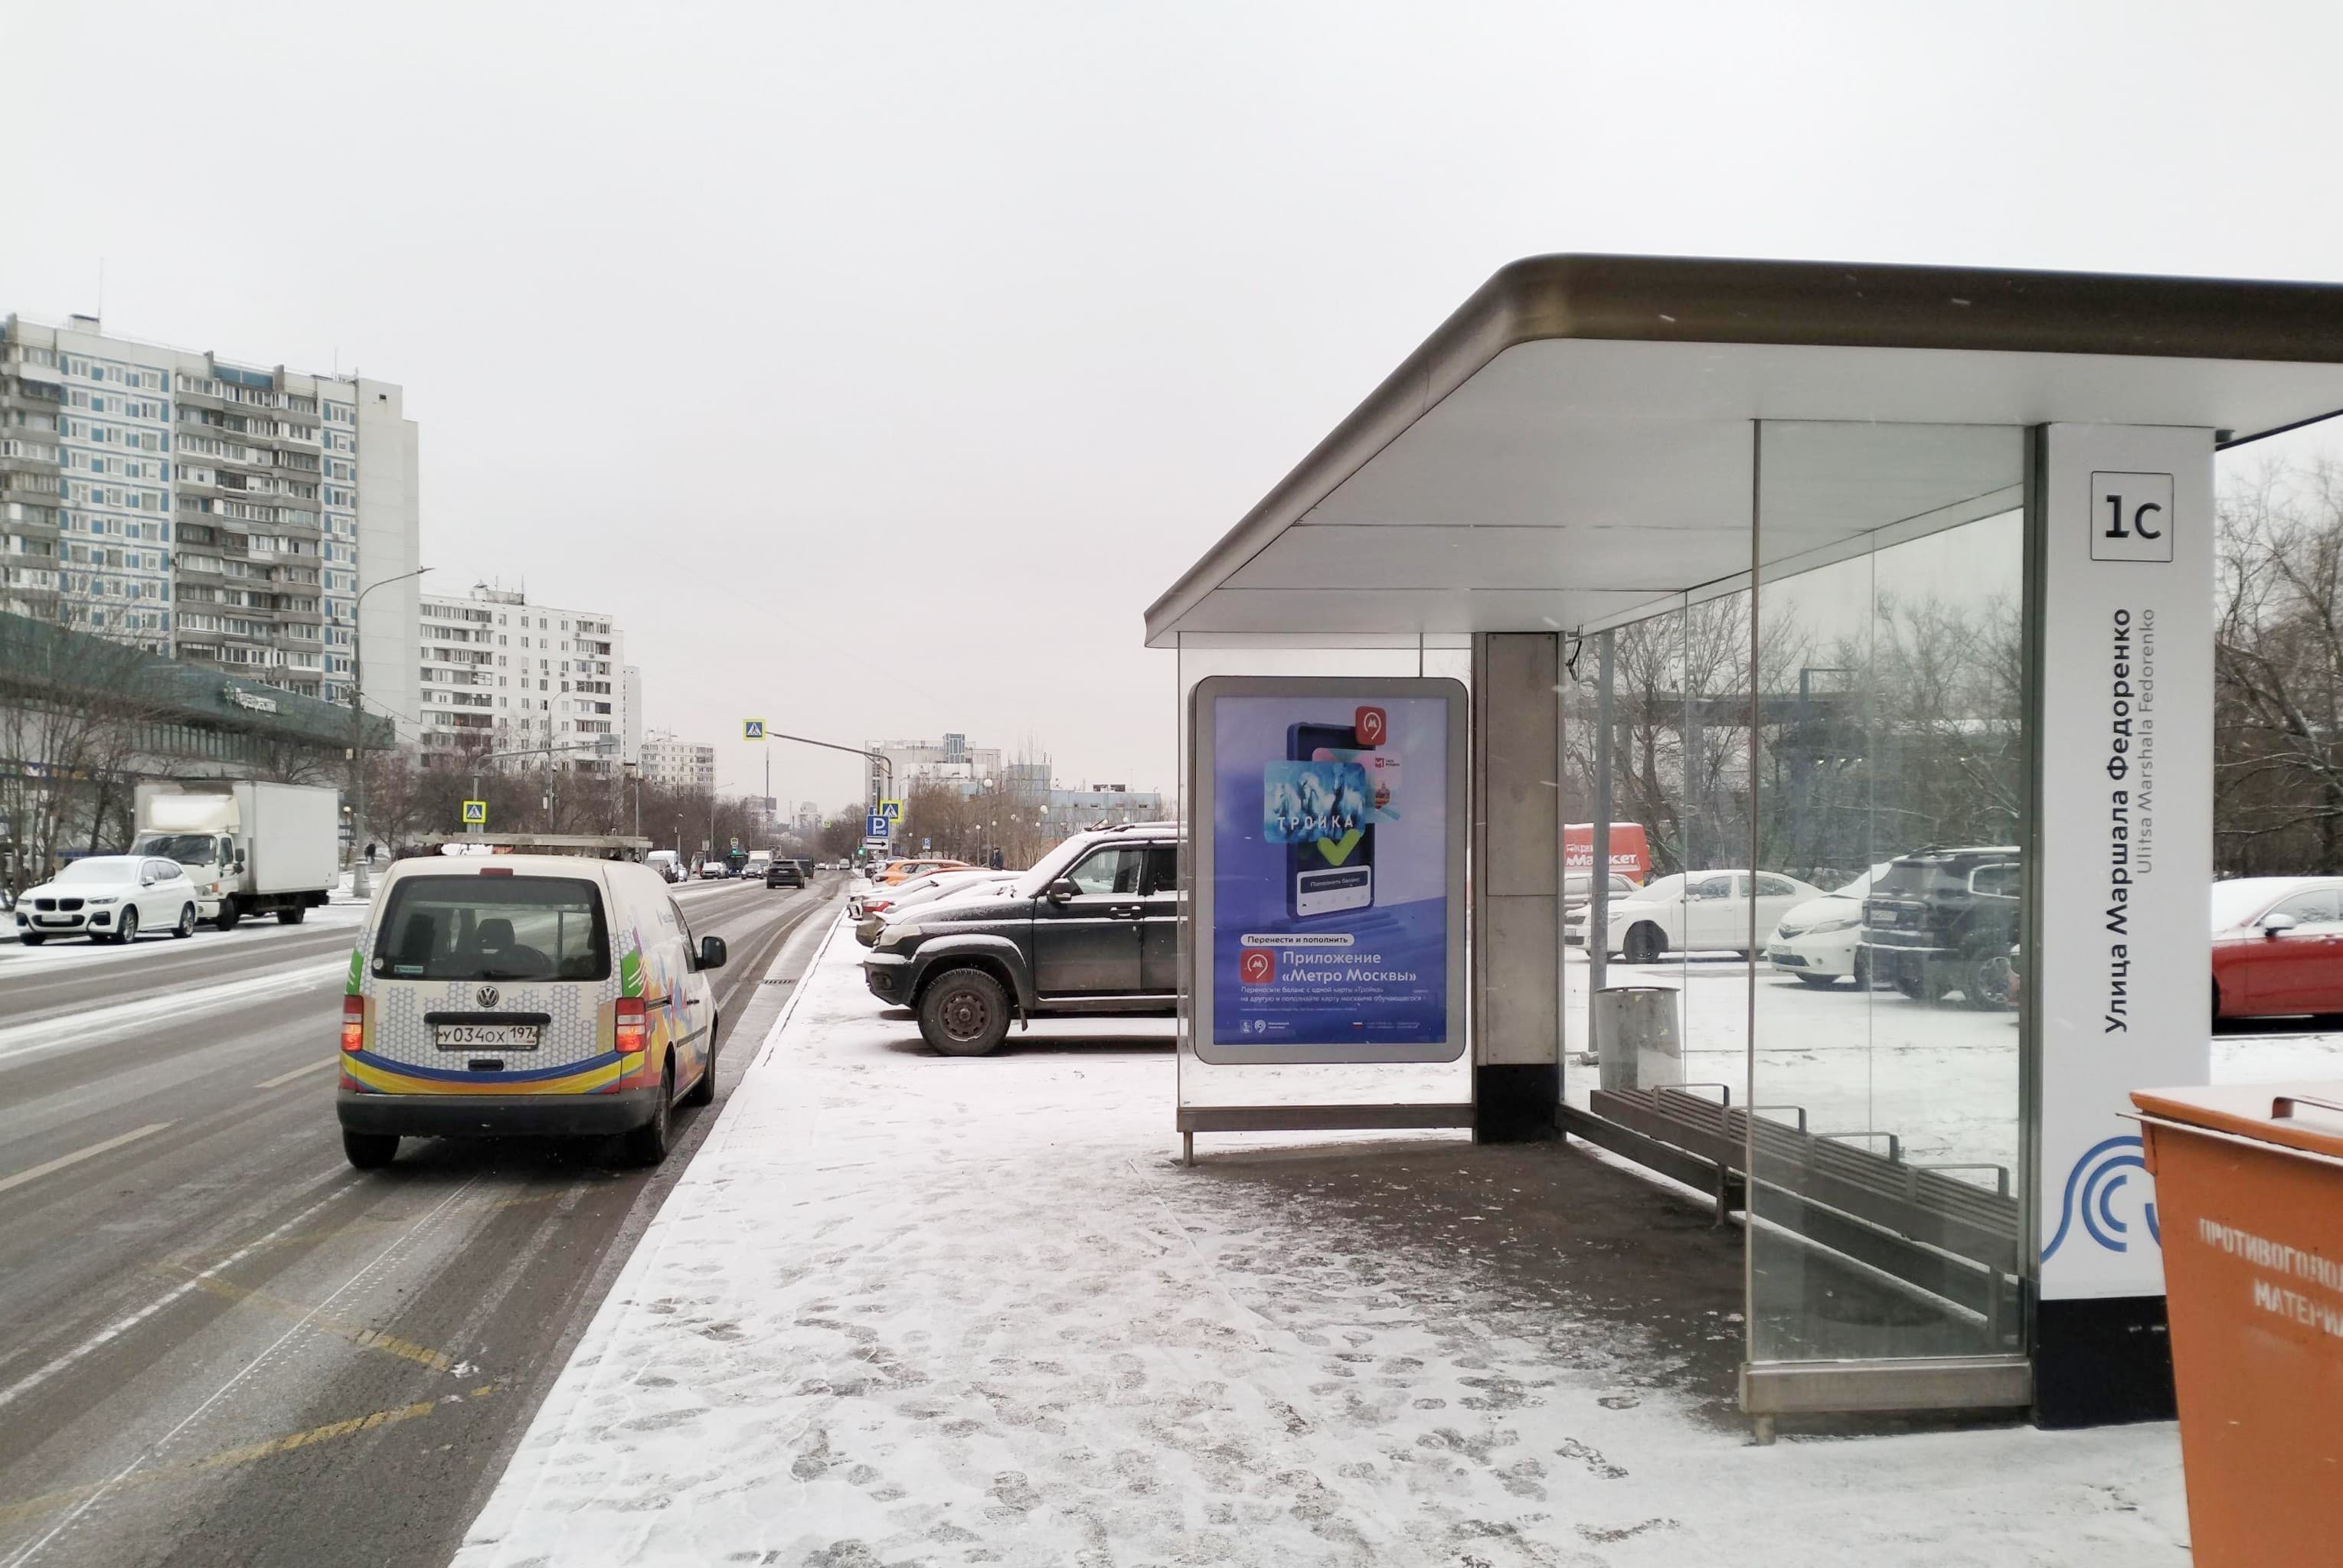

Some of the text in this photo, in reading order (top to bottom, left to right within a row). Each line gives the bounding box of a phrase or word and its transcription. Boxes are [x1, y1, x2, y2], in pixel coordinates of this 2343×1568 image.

[2136, 609, 2155, 874] Ulitsa Marshala Fedorenko
[873, 817, 886, 835] P
[1277, 815, 1354, 831] ТРОЙКА
[2106, 609, 2135, 1034] Улица Маршала Федоренко
[1567, 854, 1637, 866] Макет
[1247, 936, 1293, 944] Перенести
[1283, 951, 1381, 966] Приложение
[1282, 969, 1417, 984] «Метро Москвы»
[510, 1027, 532, 1039] 197
